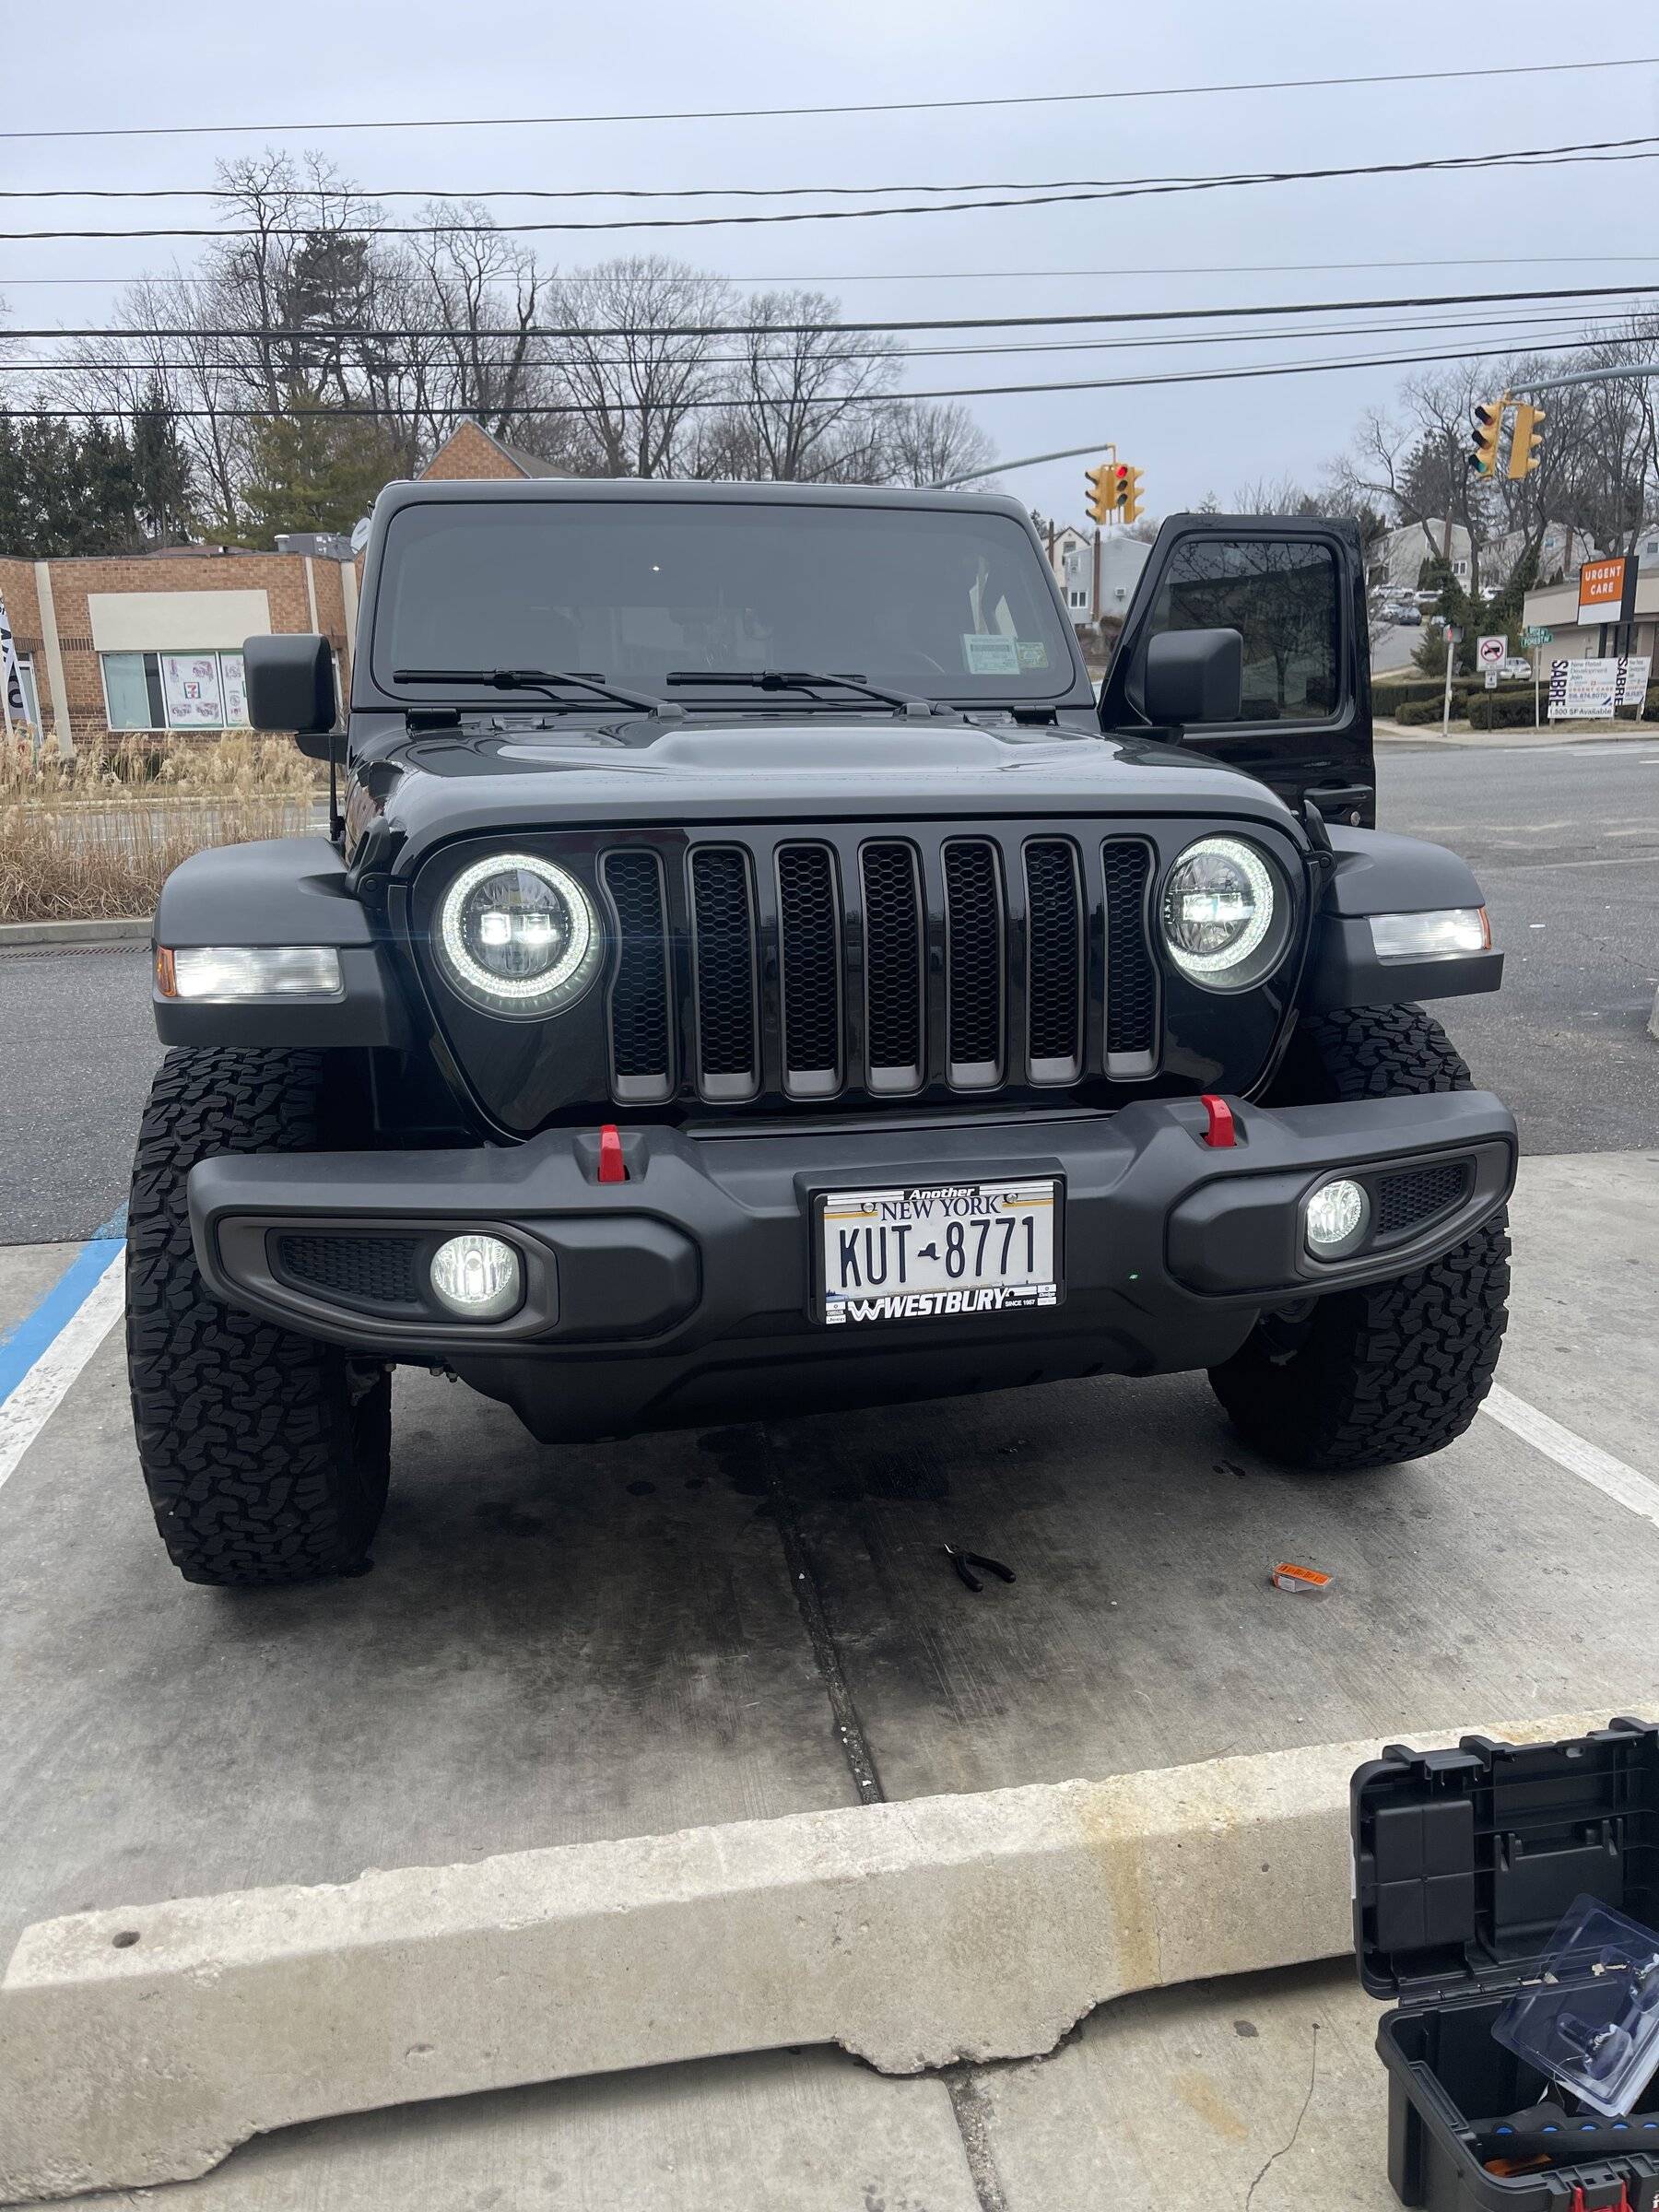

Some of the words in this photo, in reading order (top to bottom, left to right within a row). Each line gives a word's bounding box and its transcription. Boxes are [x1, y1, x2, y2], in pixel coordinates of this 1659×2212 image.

[1585, 566, 1621, 582] URGENT
[1591, 582, 1614, 595] CARE
[1548, 659, 1569, 706] SABRE
[1615, 657, 1628, 706] SABRE
[1579, 706, 1612, 715] Available
[909, 1188, 974, 1200] Another
[881, 1199, 935, 1221] NEW
[940, 1195, 1001, 1218] YORK
[840, 1224, 912, 1288] KUT
[946, 1216, 1034, 1278] 8771
[885, 1288, 1009, 1319] WESTBURY
[1005, 1300, 1022, 1308] SINCE
